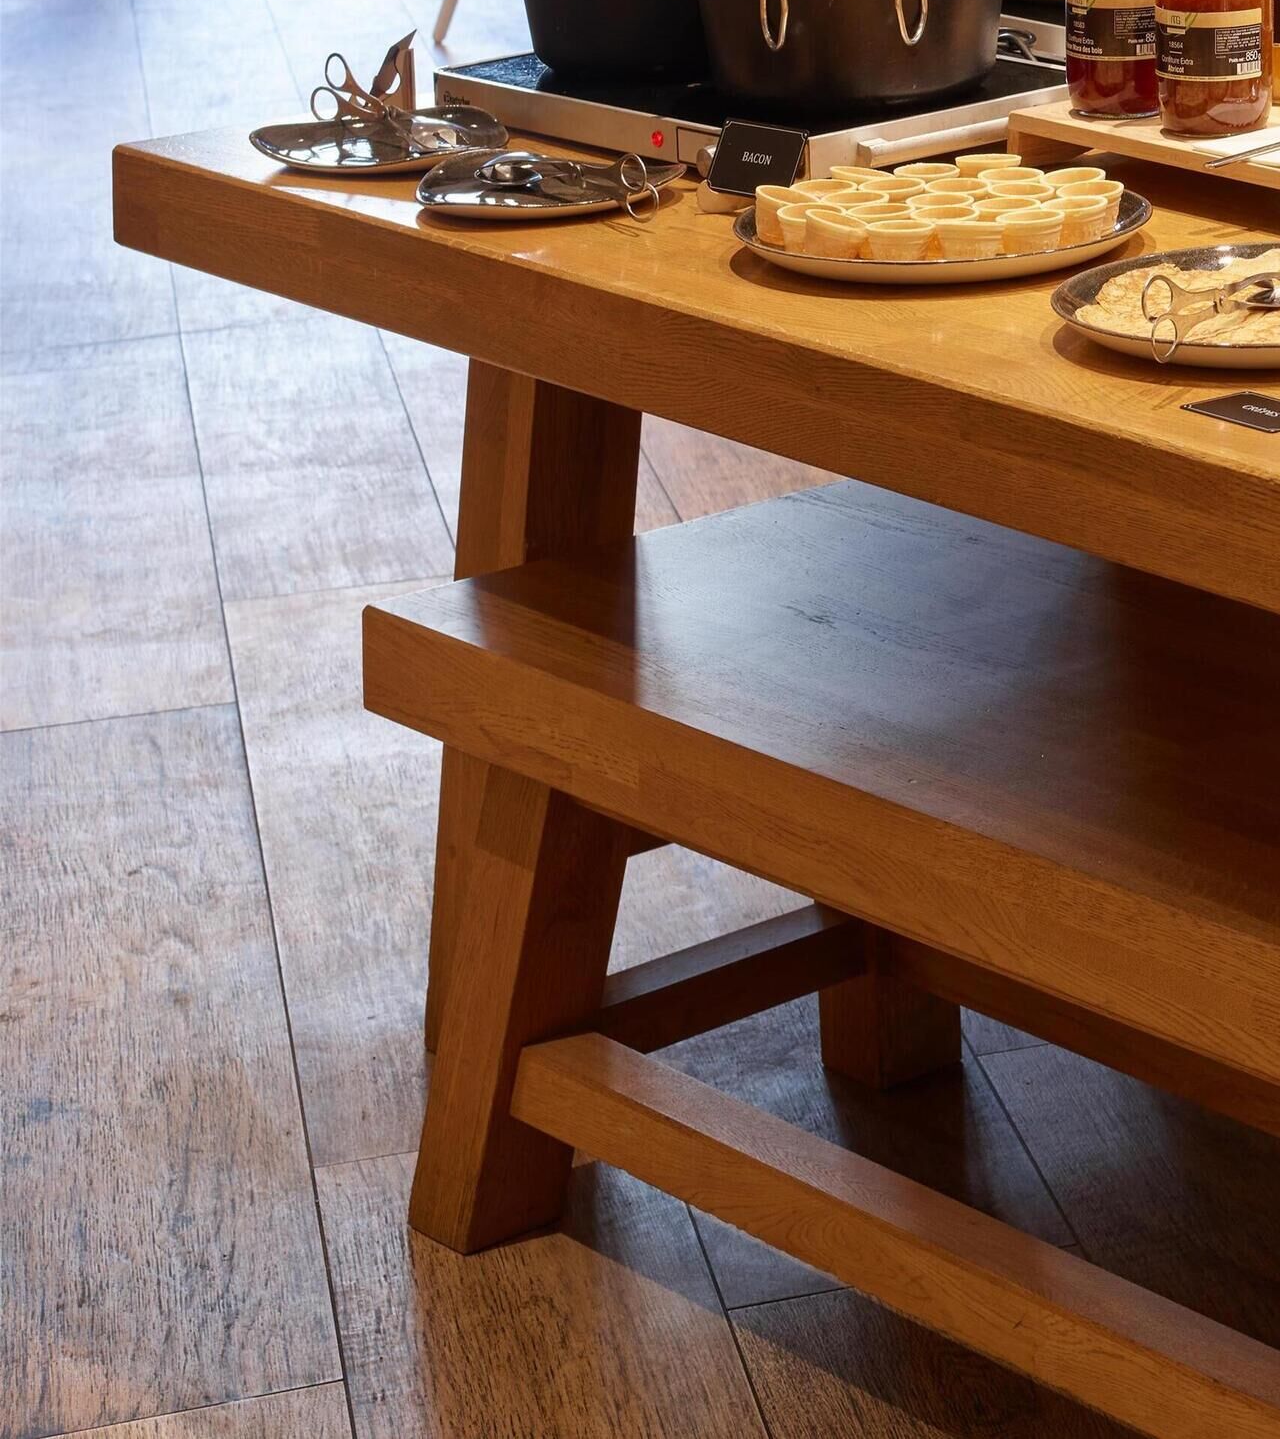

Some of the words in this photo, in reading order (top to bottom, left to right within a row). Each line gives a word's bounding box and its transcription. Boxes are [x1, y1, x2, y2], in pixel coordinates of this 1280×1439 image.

[1180, 57, 1194, 66] Extra
[1167, 64, 1185, 74] Abricot
[741, 151, 772, 165] BACON
